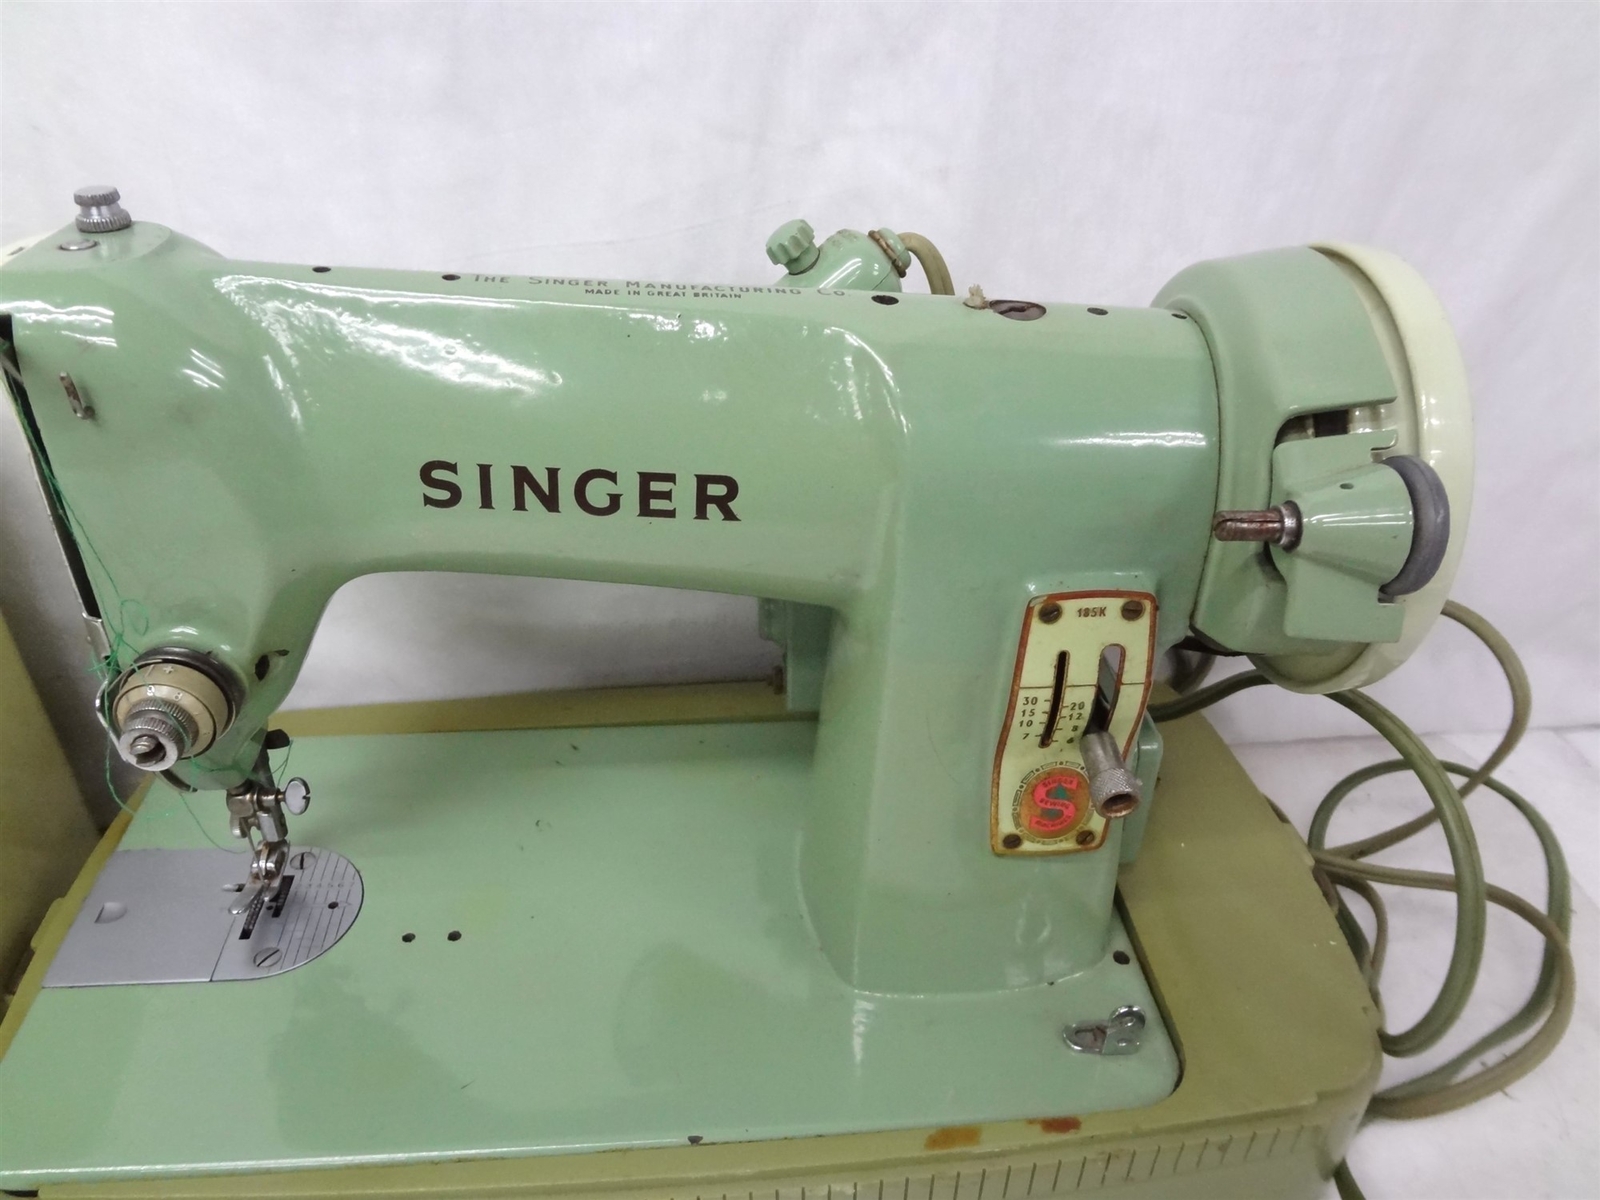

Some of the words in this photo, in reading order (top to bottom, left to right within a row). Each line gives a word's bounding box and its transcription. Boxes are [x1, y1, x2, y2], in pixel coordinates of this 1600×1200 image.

[474, 274, 511, 283] THE
[528, 276, 608, 287] SINGER
[625, 281, 802, 295] MANUFACTURING
[647, 290, 686, 298] GREAT
[419, 459, 742, 522] SINGER
[1077, 606, 1107, 618] 185K
[1022, 696, 1038, 706] 30
[1070, 701, 1085, 711] 20
[1021, 708, 1036, 717] 15
[1068, 712, 1083, 721] 12
[1019, 719, 1033, 728] 10
